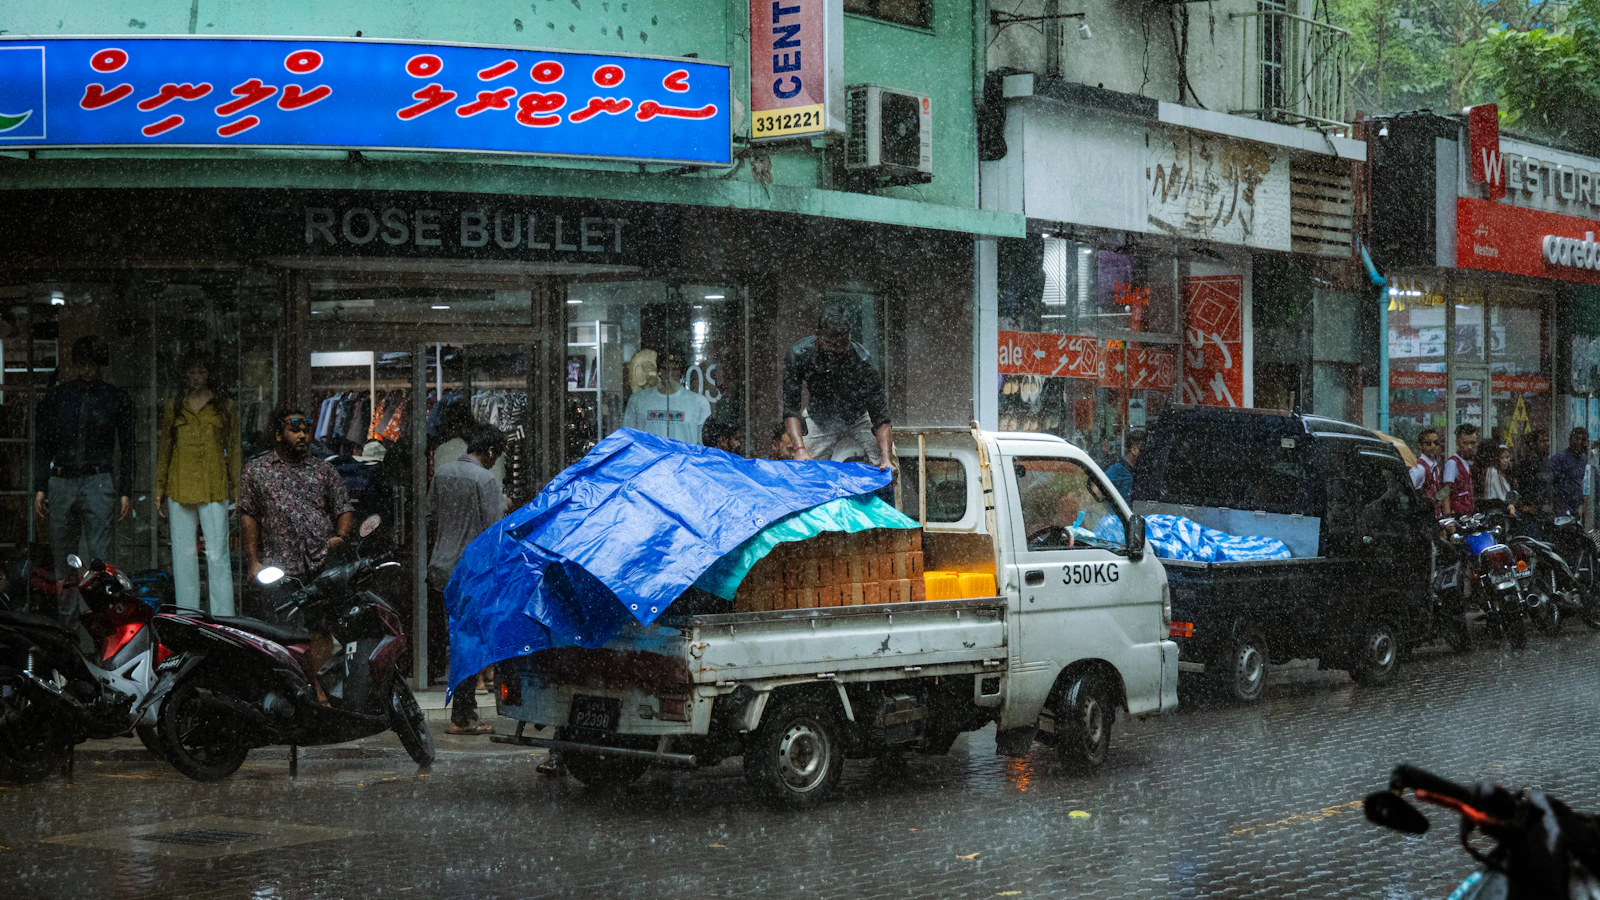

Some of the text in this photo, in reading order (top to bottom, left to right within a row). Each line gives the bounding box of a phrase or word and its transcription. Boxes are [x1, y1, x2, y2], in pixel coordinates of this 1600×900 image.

[772, 1, 802, 100] CENT
[756, 111, 820, 132] 3312221
[304, 207, 629, 255] ROSE BULLET
[1473, 241, 1499, 259] Westore
[998, 339, 1023, 367] ale
[1062, 563, 1120, 585] 350KG
